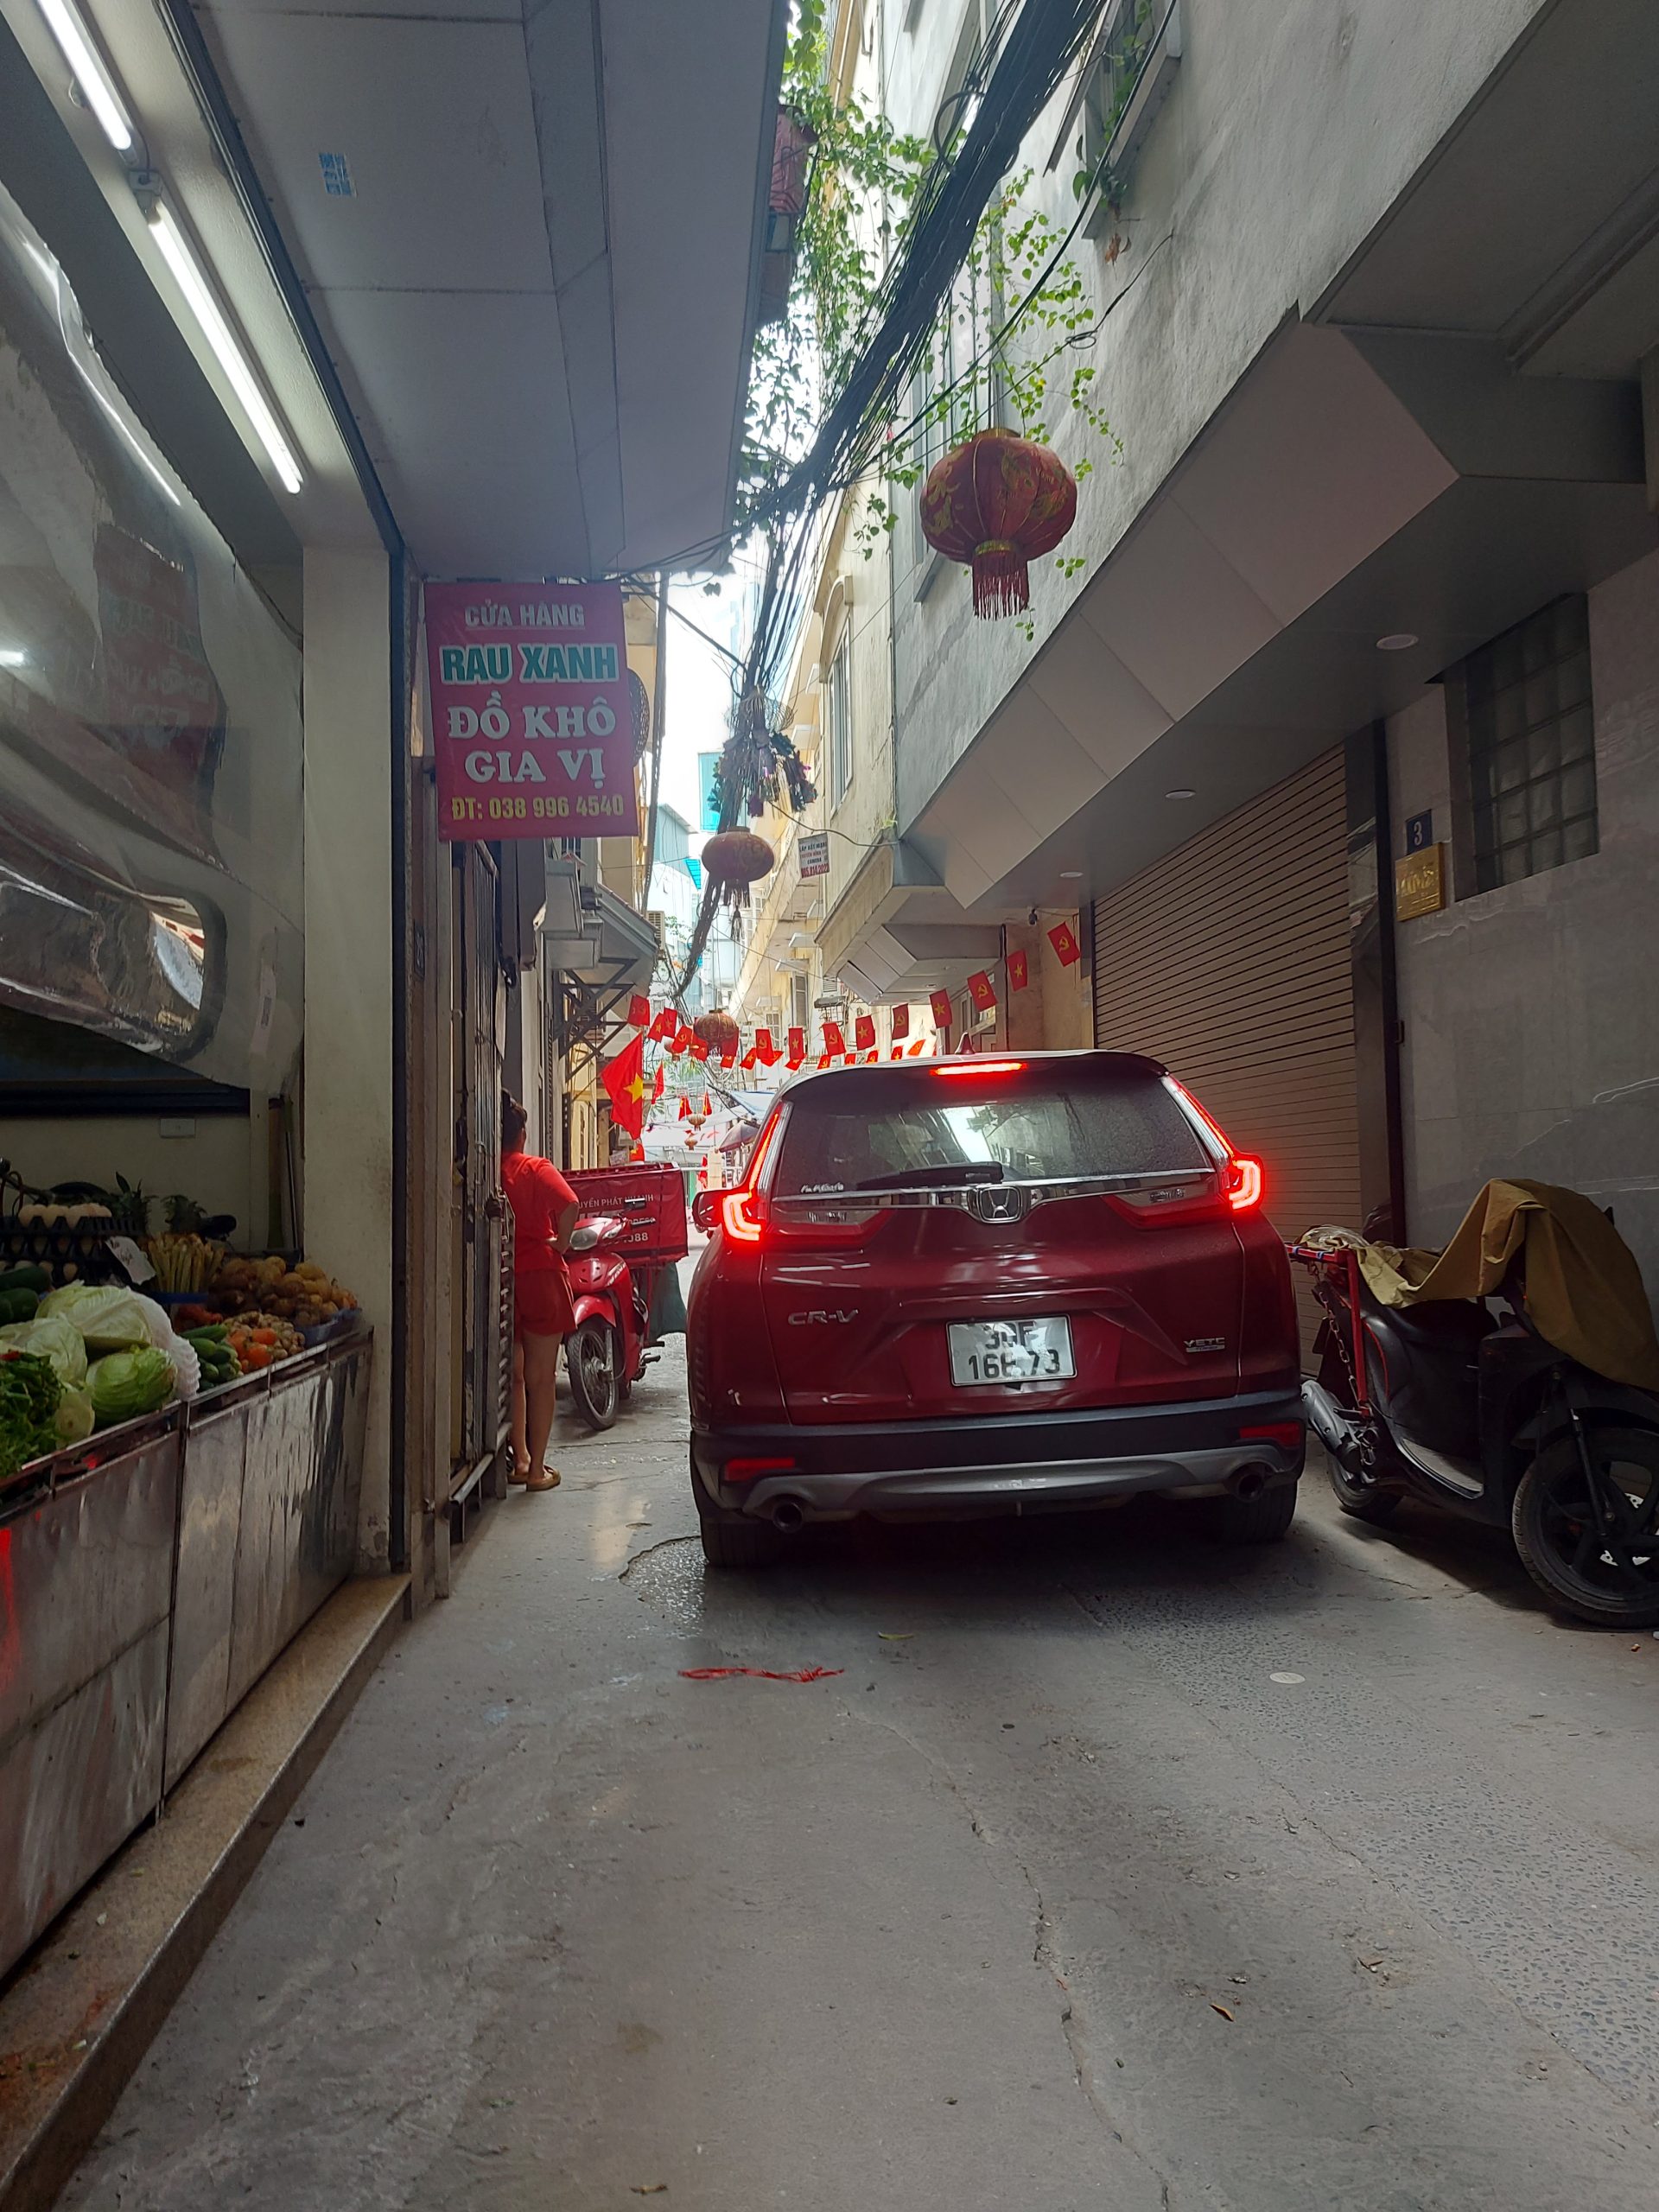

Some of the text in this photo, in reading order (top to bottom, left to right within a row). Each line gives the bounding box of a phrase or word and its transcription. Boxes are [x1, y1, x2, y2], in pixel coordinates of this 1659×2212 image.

[465, 599, 512, 627] CỬA
[440, 643, 619, 684] RAU XANH
[448, 690, 616, 740] ĐỒ KHÔ
[465, 748, 605, 789] GIA VỊ
[452, 794, 624, 820] ĐT: 038 996 4540
[1414, 821, 1423, 846] 3
[601, 1197, 622, 1206] PHÁT
[788, 1309, 859, 1325] CR-V
